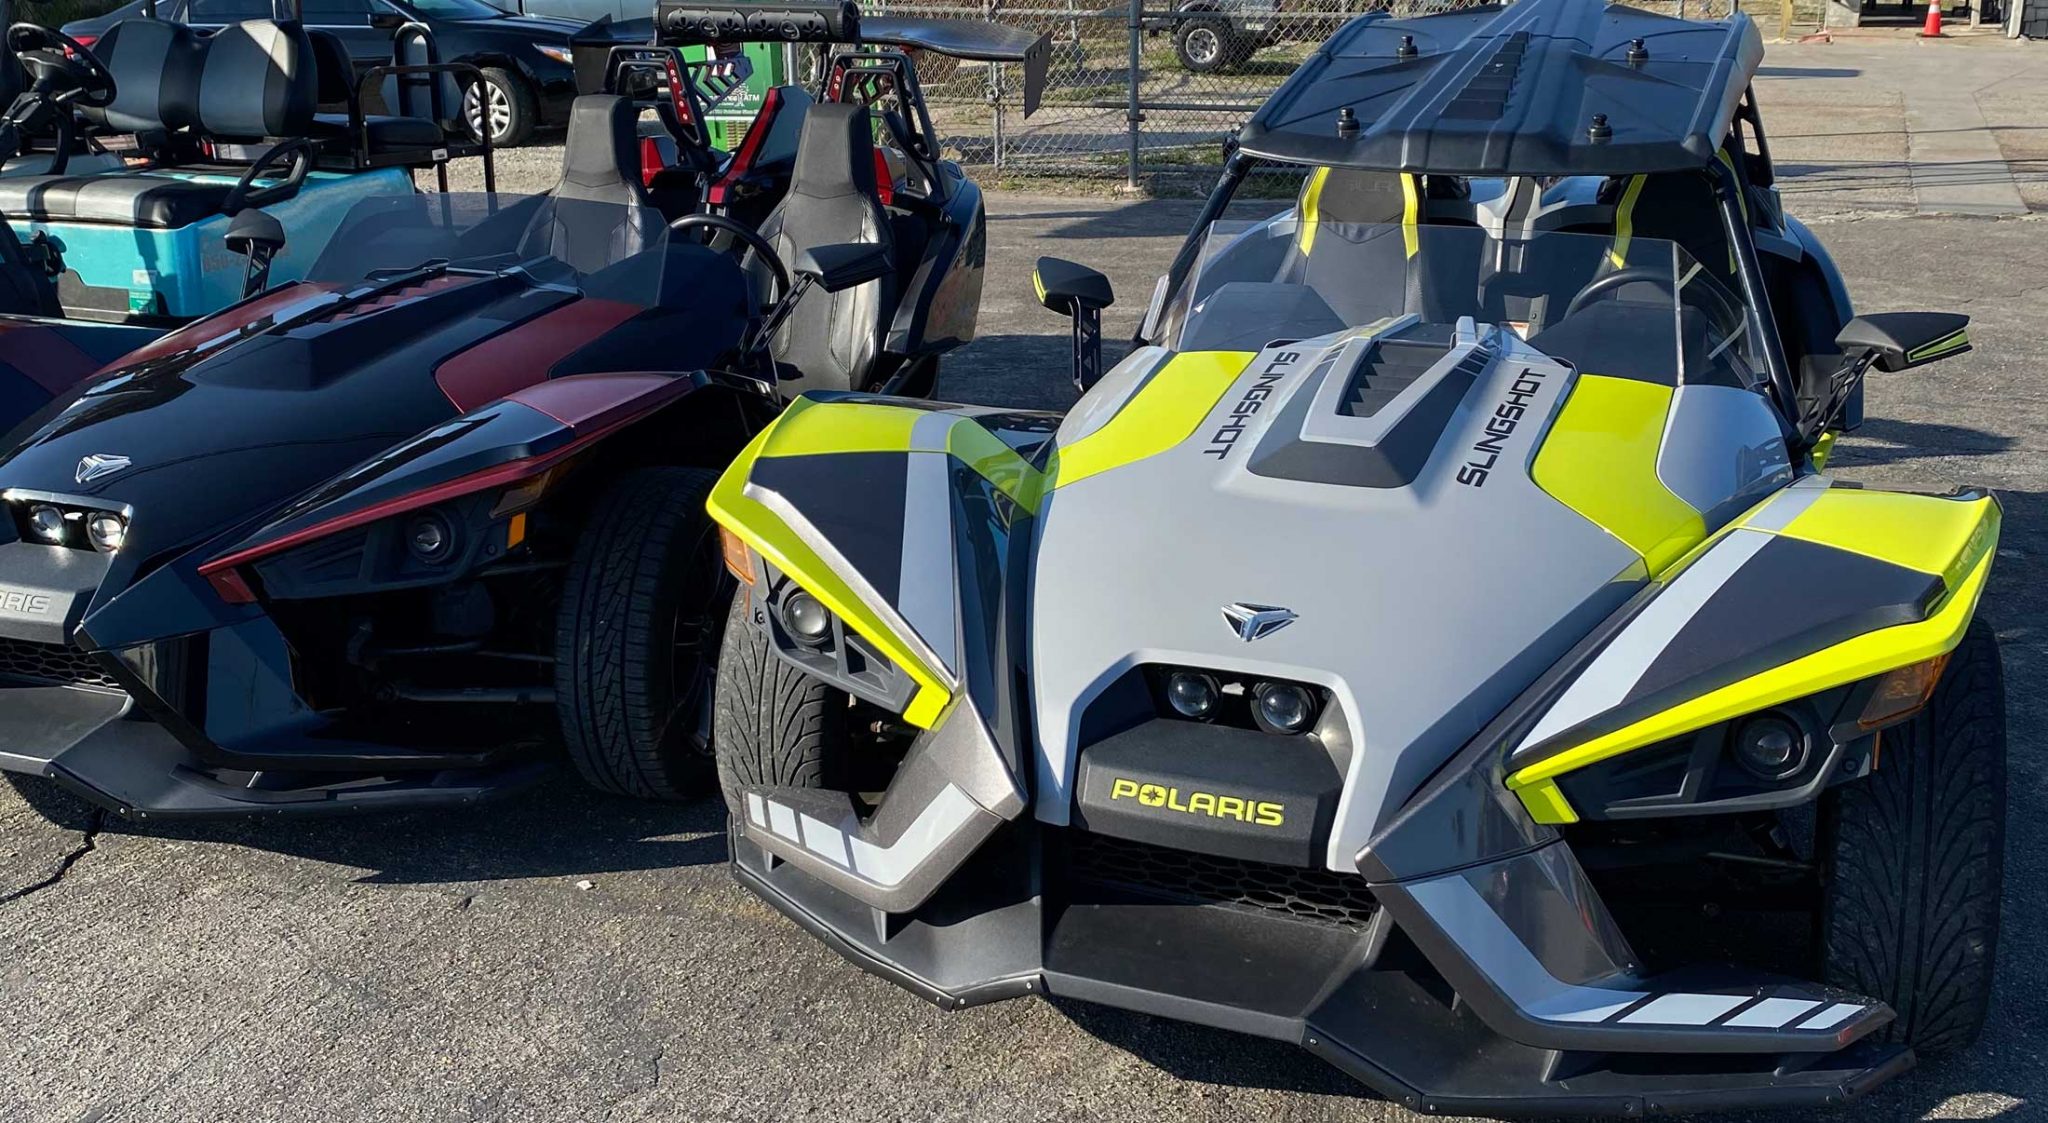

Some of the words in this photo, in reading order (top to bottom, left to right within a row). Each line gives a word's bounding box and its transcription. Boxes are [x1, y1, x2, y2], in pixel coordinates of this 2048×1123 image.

[743, 94, 760, 102] ATM
[1203, 352, 1301, 461] SLINGSHOT
[1456, 367, 1546, 488] SLINGSHOT
[1111, 778, 1284, 827] POLARIS
